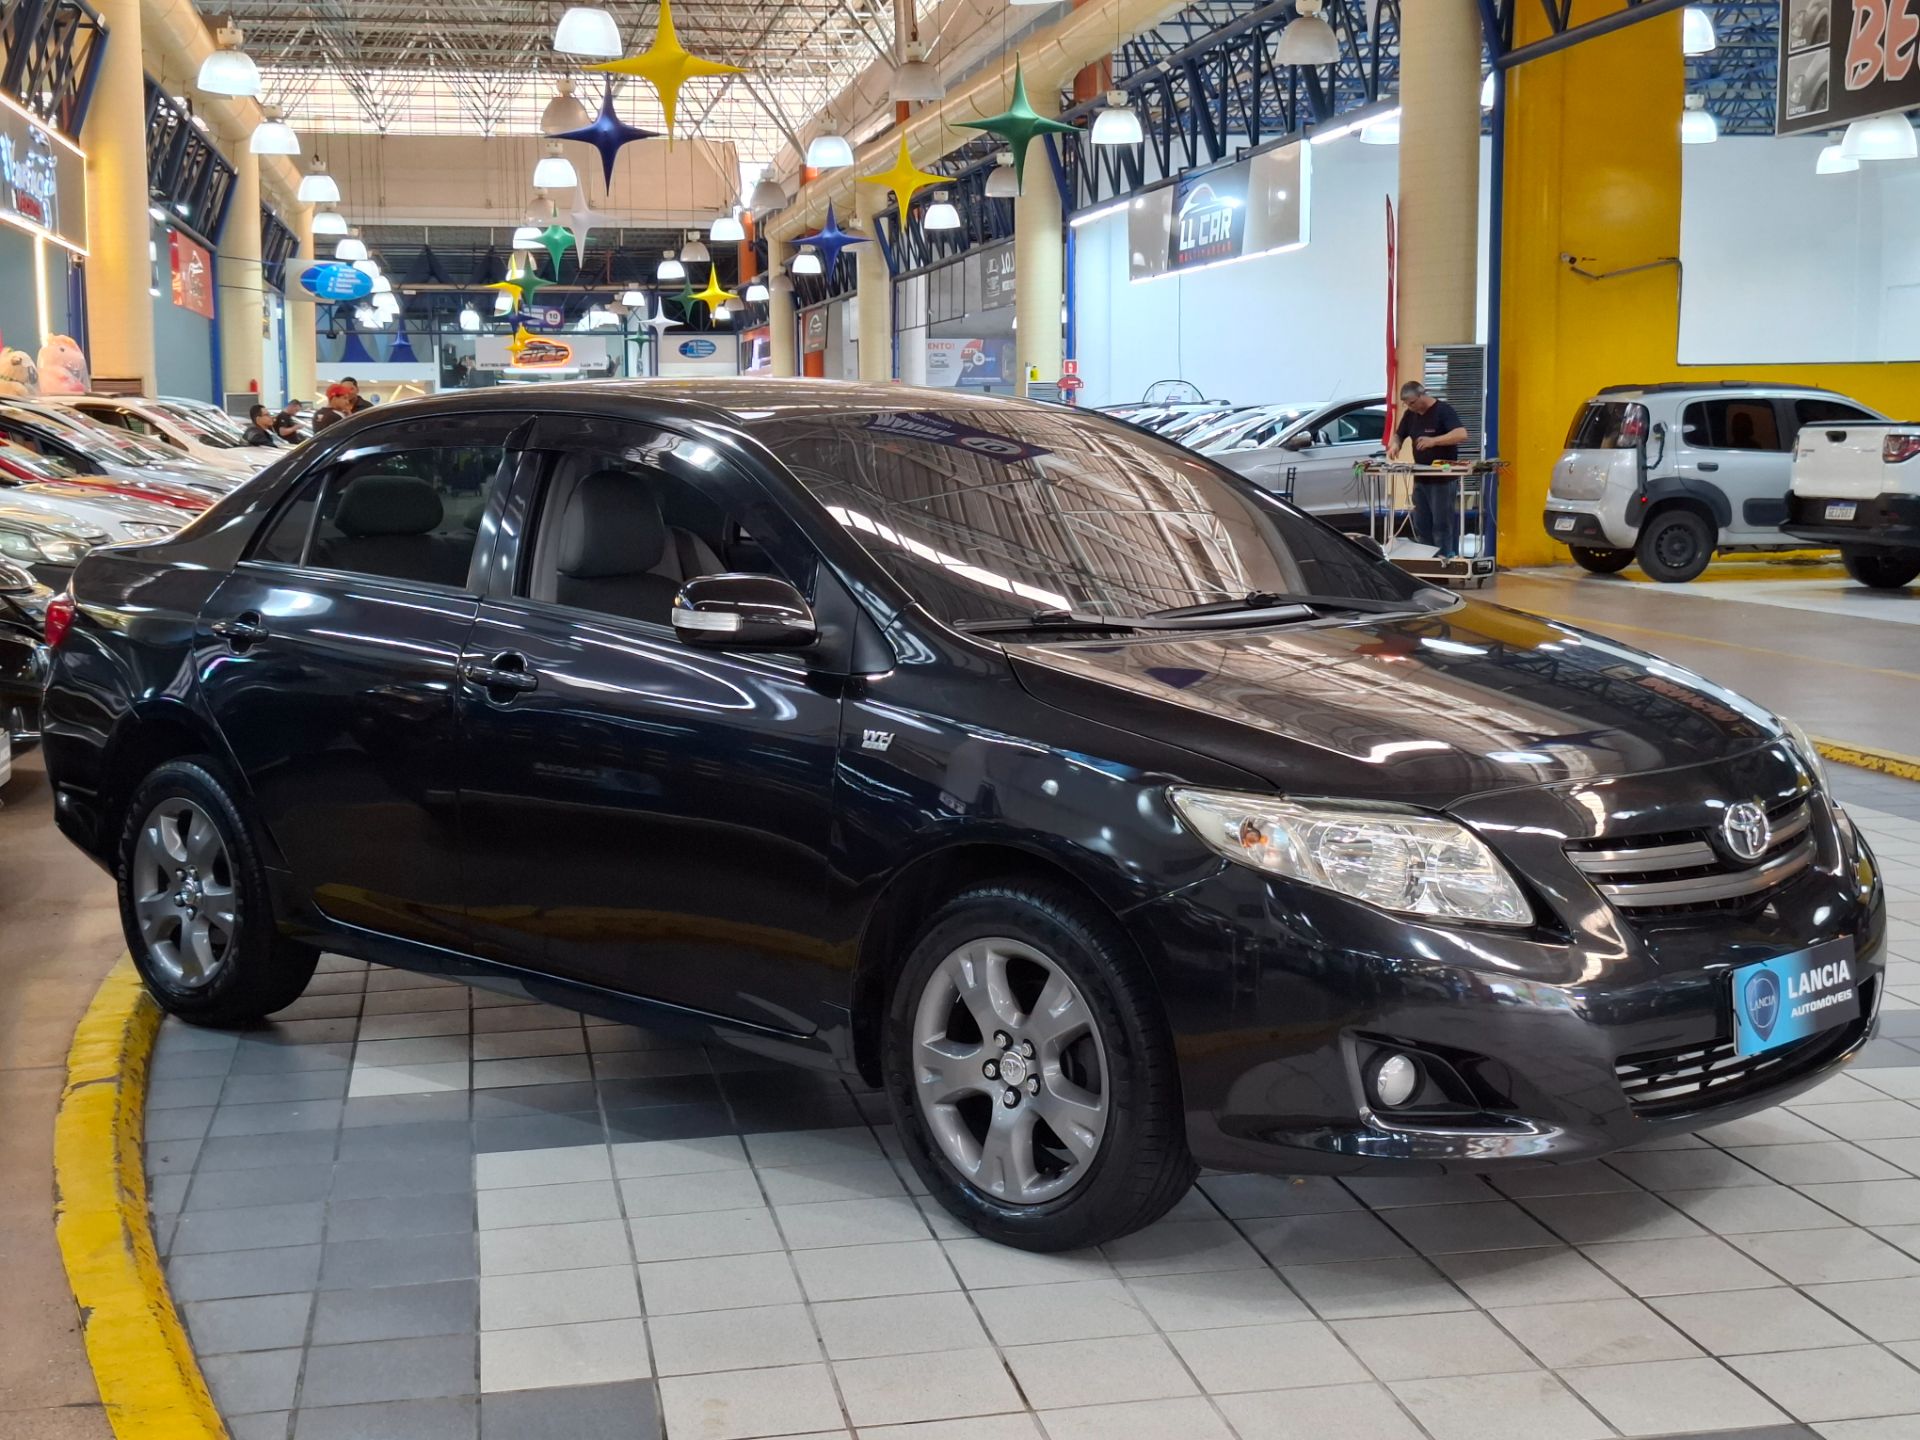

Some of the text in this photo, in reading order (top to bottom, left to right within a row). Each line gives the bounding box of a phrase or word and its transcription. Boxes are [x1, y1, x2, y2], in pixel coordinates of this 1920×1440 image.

[1845, 0, 1920, 91] BE
[1199, 207, 1232, 246] CAR
[549, 312, 558, 320] 10
[1787, 960, 1851, 999] LANCIA
[1750, 995, 1777, 1011] LANCIA
[1791, 989, 1853, 1018] AUTOMÓVEIS
